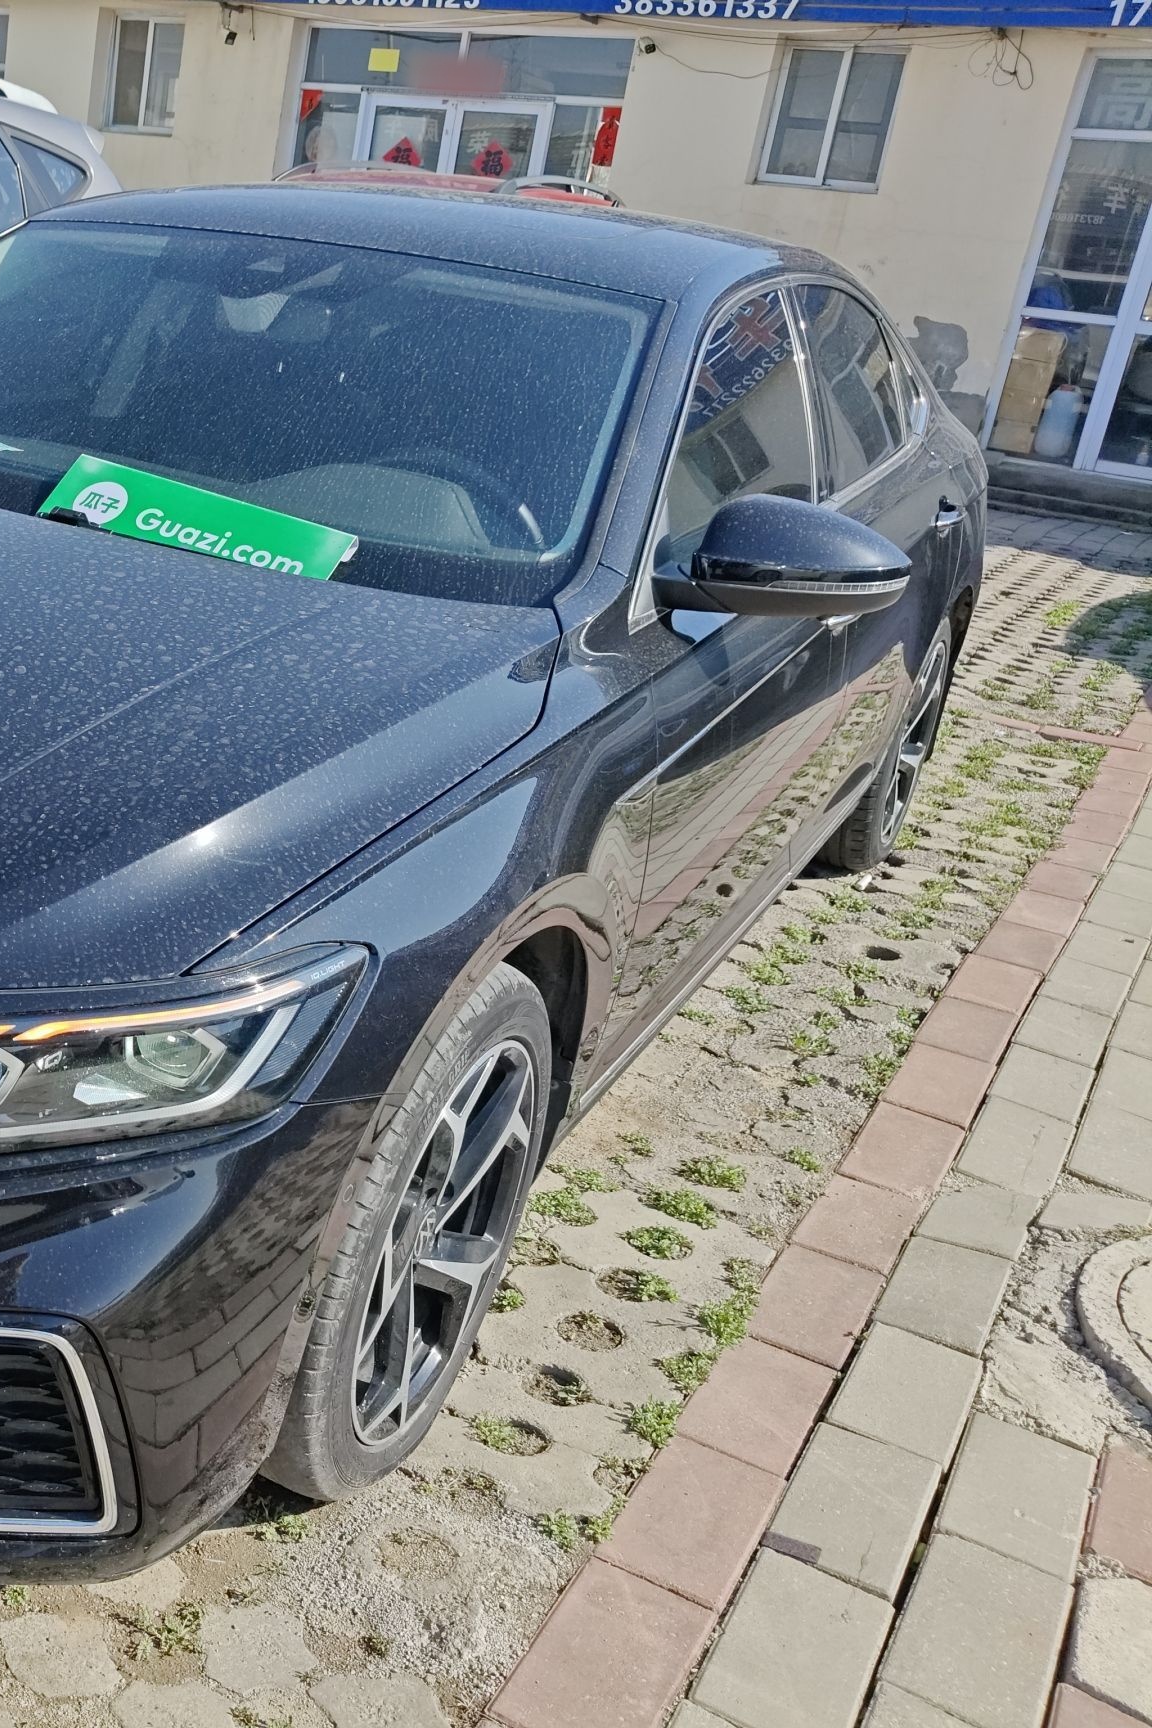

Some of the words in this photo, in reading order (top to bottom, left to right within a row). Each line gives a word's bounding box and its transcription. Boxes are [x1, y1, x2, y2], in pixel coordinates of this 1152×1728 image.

[481, 150, 503, 176] 福
[79, 490, 121, 514] 瓜子
[135, 508, 304, 575] Guazi.com
[310, 960, 345, 981] IQ.LIGHT
